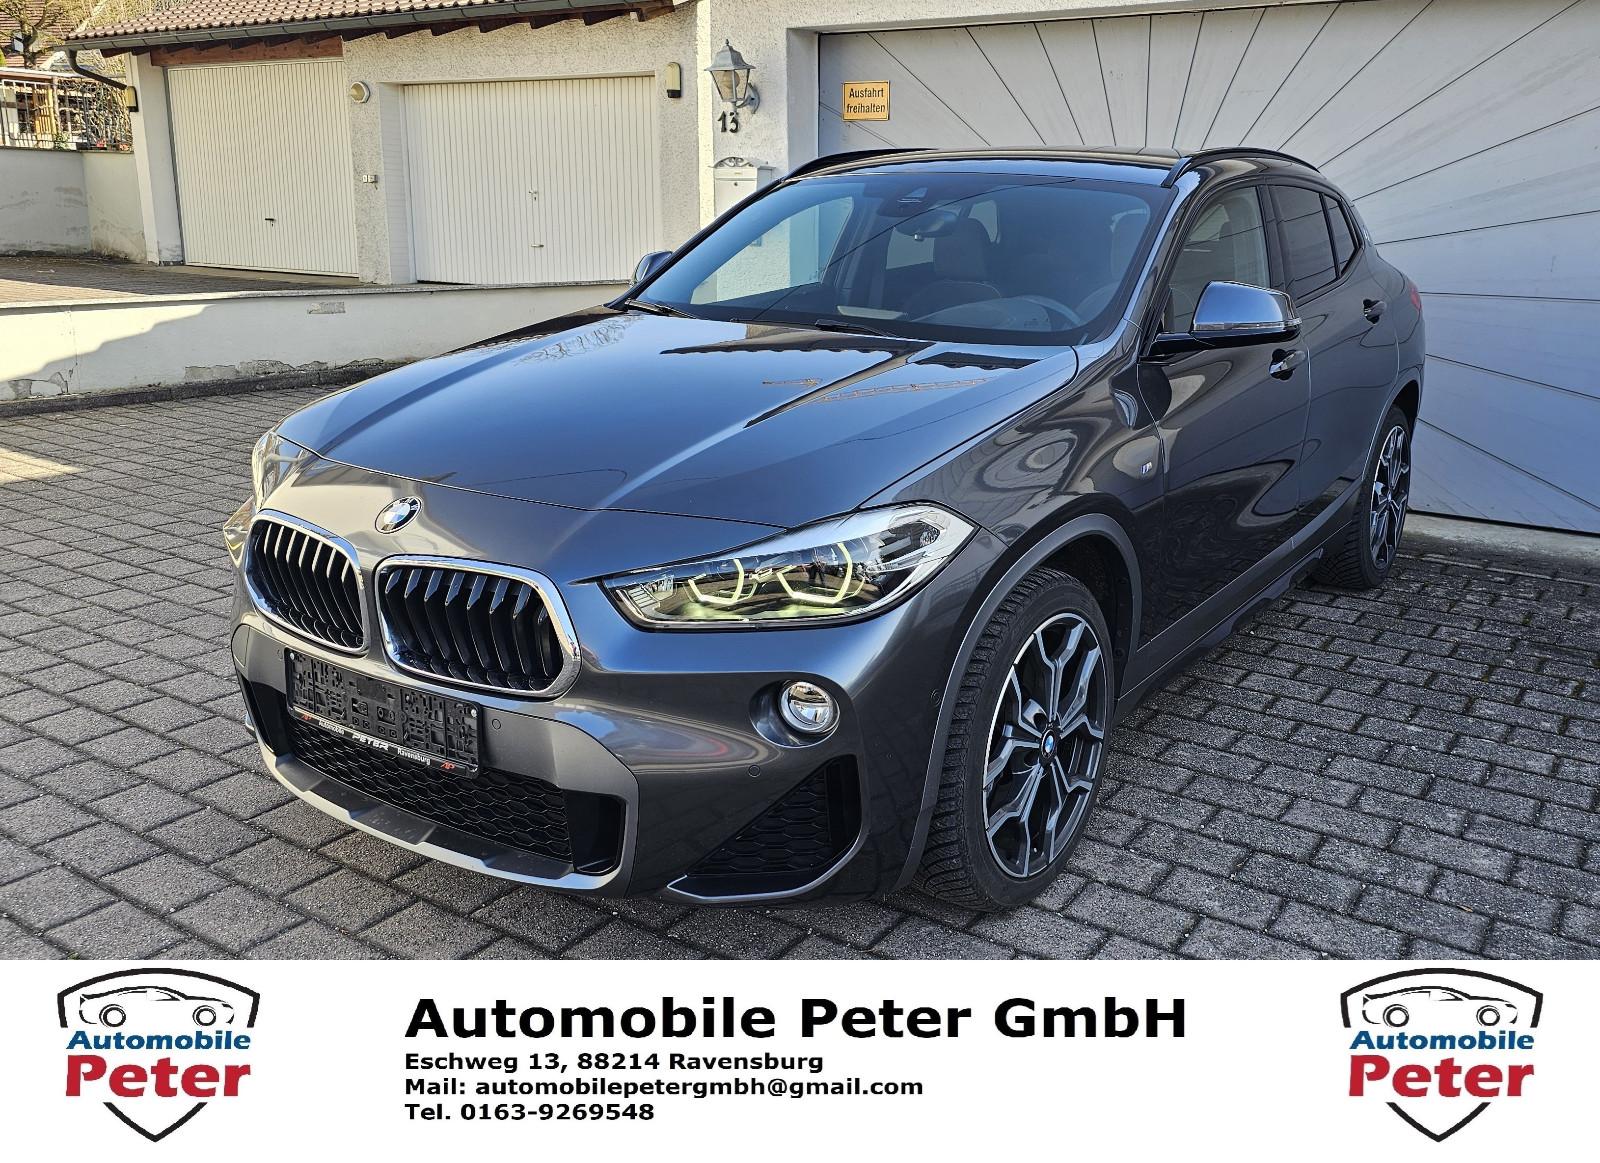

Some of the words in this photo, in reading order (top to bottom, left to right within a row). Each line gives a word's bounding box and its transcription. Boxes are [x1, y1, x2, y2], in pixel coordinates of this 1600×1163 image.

[849, 87, 884, 98] Ausfahrt
[847, 103, 886, 114] freihalten
[718, 111, 739, 133] 13
[397, 747, 431, 766] Ravensburg
